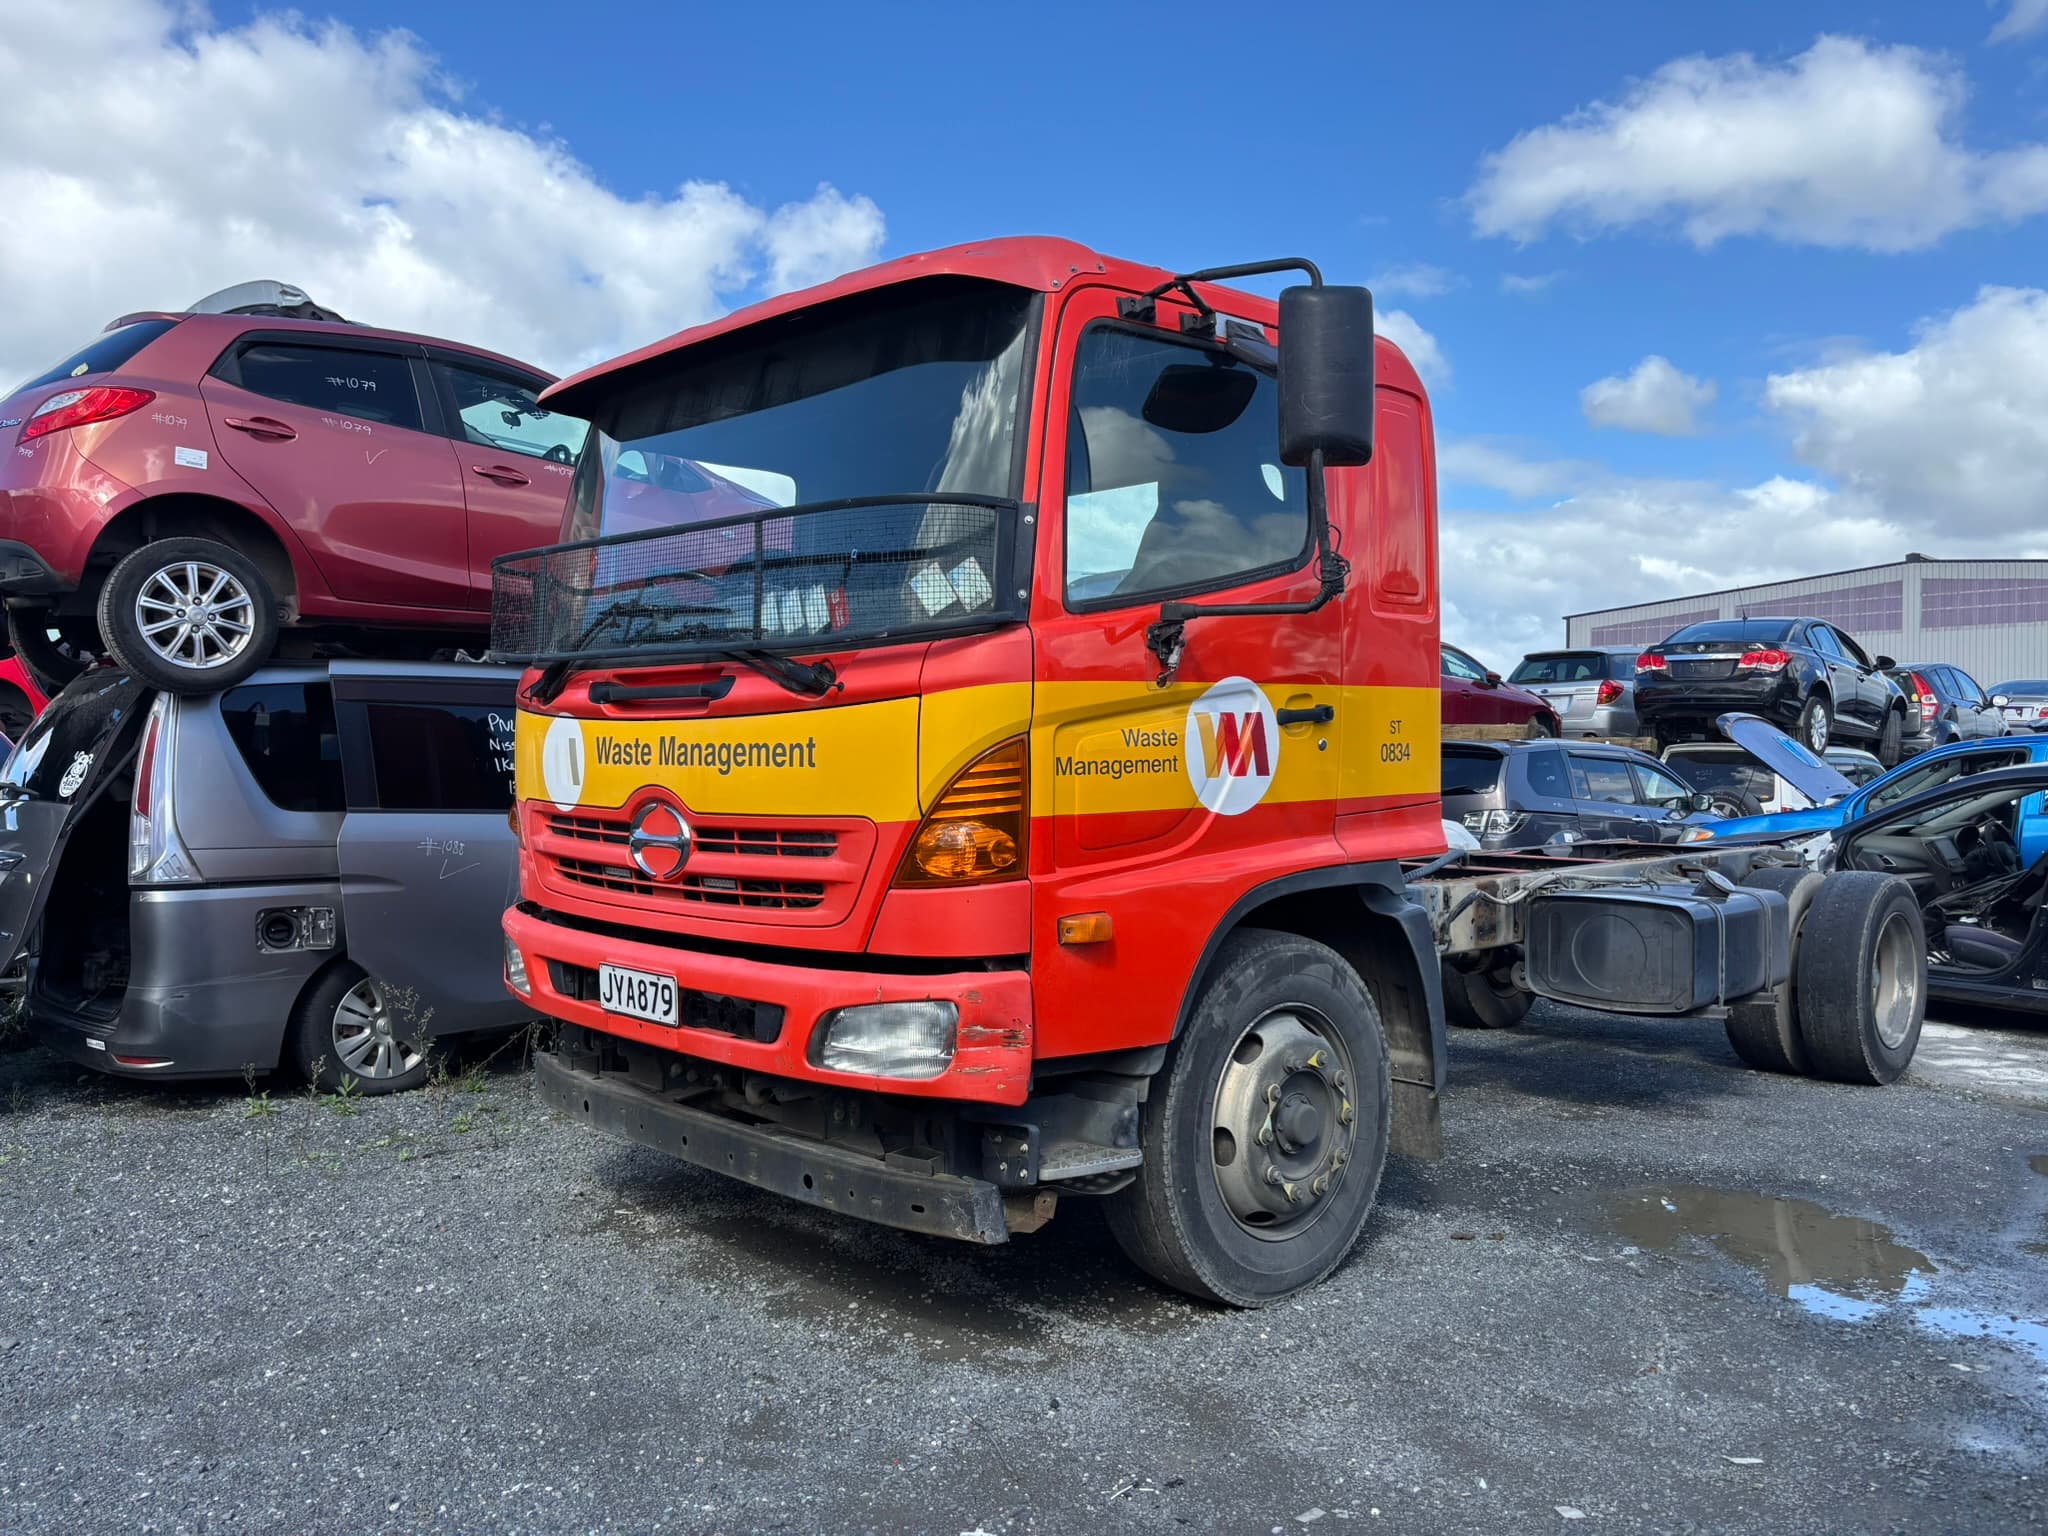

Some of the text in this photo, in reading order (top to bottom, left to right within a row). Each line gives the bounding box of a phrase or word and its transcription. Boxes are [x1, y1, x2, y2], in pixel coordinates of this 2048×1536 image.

[324, 376, 377, 392] #1079
[321, 417, 372, 436] #1079
[1390, 719, 1402, 734] ST
[1120, 728, 1179, 748] Waste
[595, 735, 817, 776] Waste Management
[1380, 742, 1411, 762] 0834
[1055, 755, 1179, 780] Management
[602, 972, 673, 1017] JYA879
